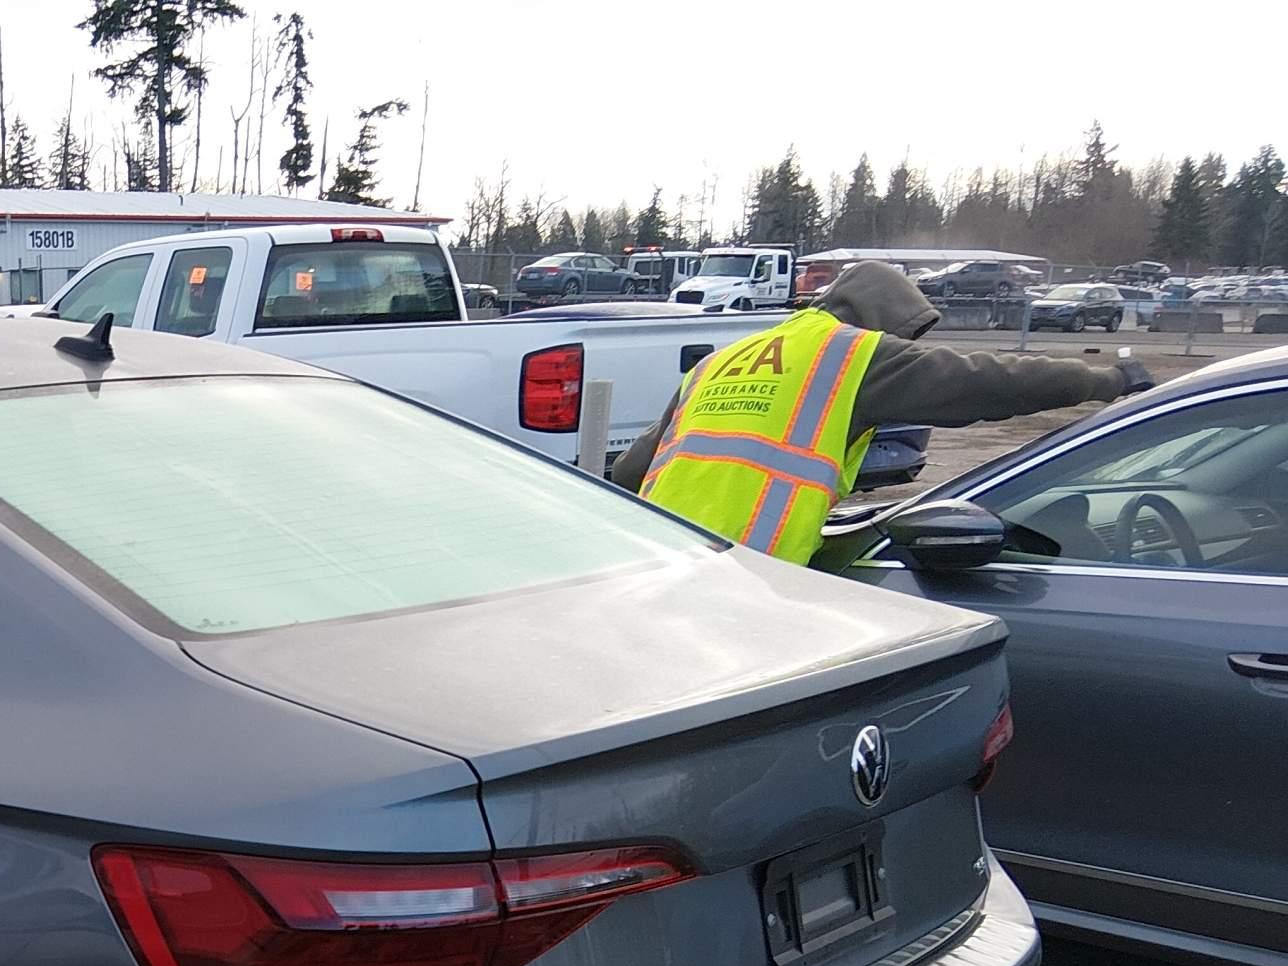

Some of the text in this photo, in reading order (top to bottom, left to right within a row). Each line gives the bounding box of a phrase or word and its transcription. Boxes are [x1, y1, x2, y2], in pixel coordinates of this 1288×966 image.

[28, 230, 74, 249] 15801B
[699, 384, 779, 400] INSURANCE
[717, 401, 771, 413] AUCTIONS
